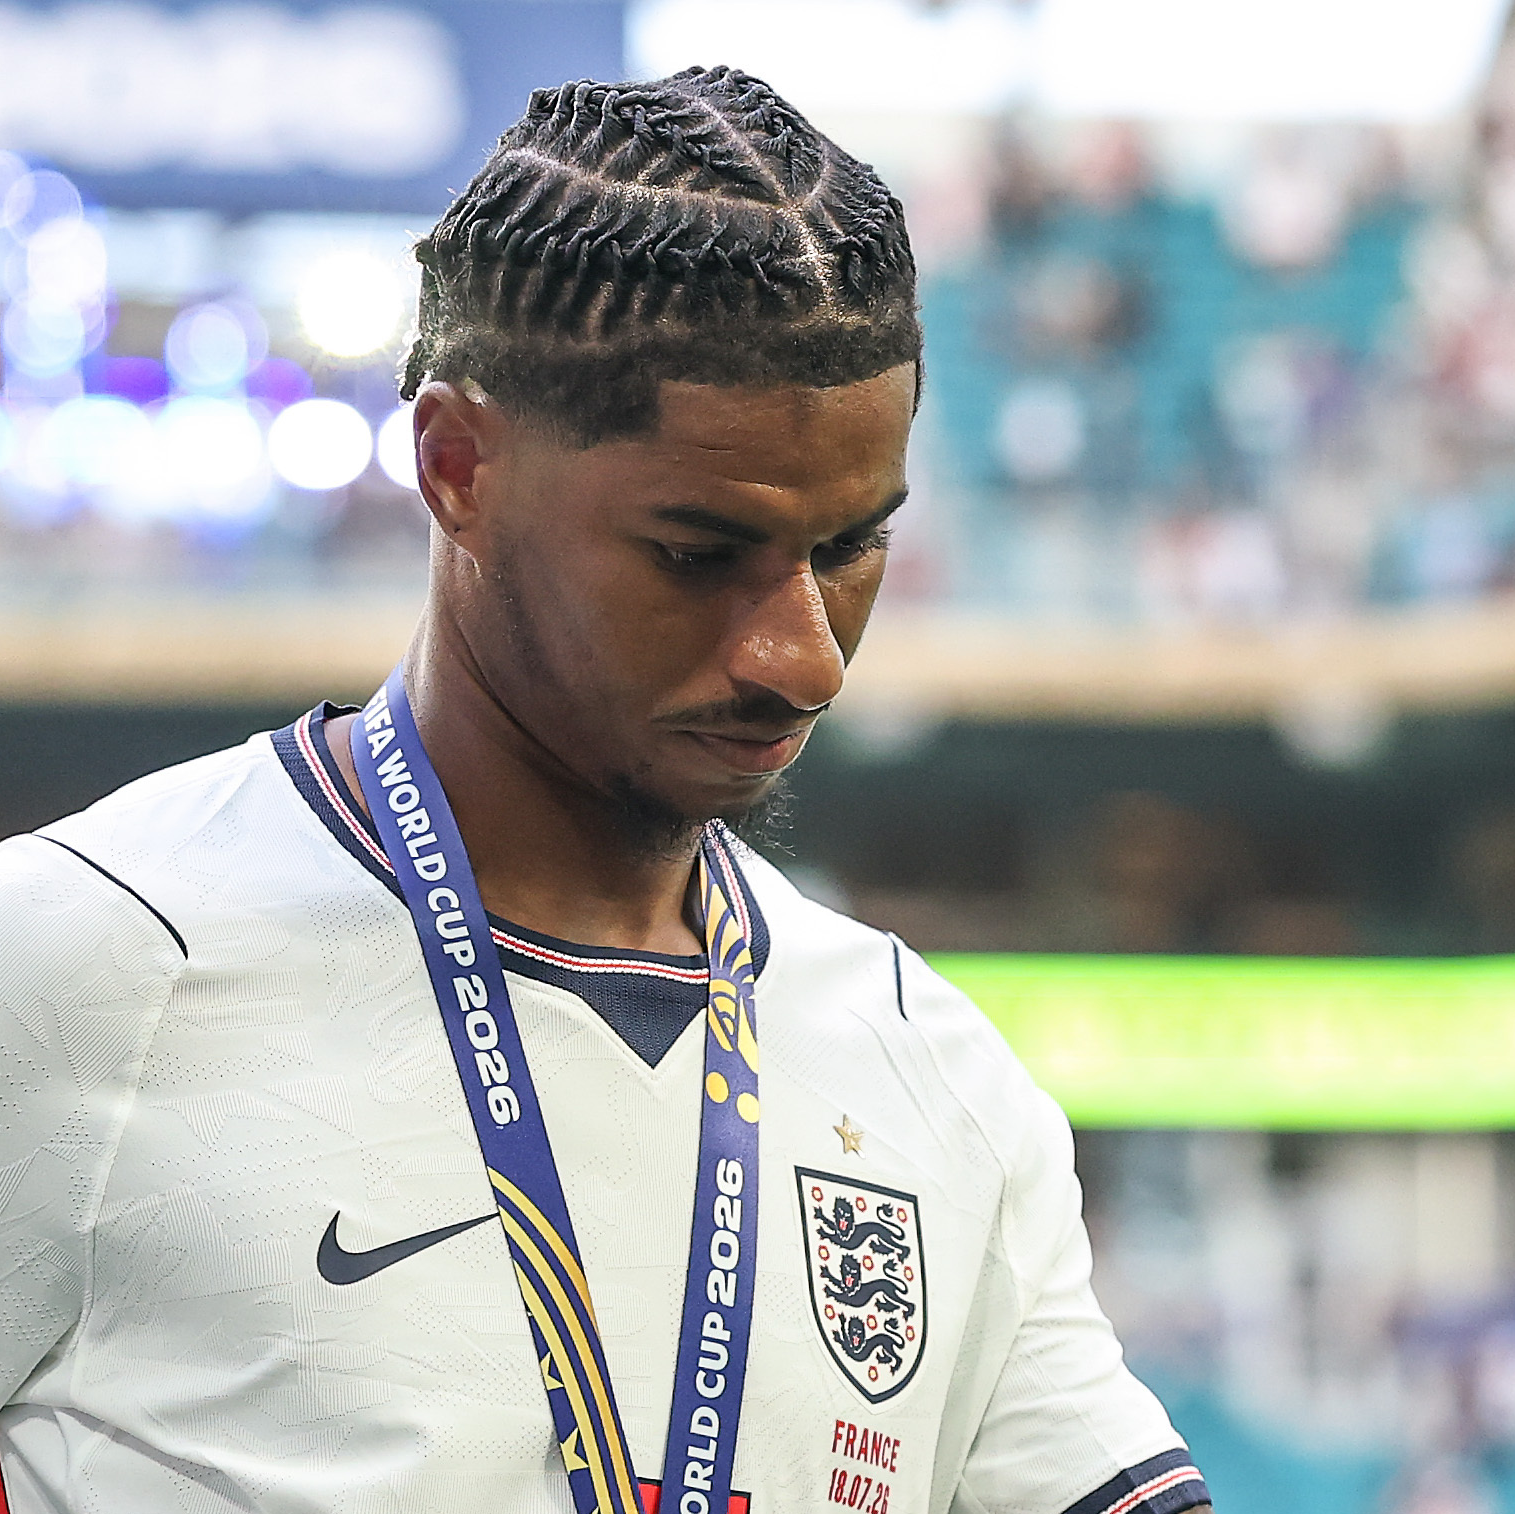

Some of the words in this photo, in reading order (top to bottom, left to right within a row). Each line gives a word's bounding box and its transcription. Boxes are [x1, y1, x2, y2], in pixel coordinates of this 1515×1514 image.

[363, 685, 397, 760] FIFA
[376, 747, 448, 882] WORLD
[427, 887, 476, 967] CUP
[452, 974, 521, 1125] 2026
[706, 1158, 744, 1308] 2026
[695, 1311, 731, 1399] CUP
[831, 1418, 901, 1474] FRANCE
